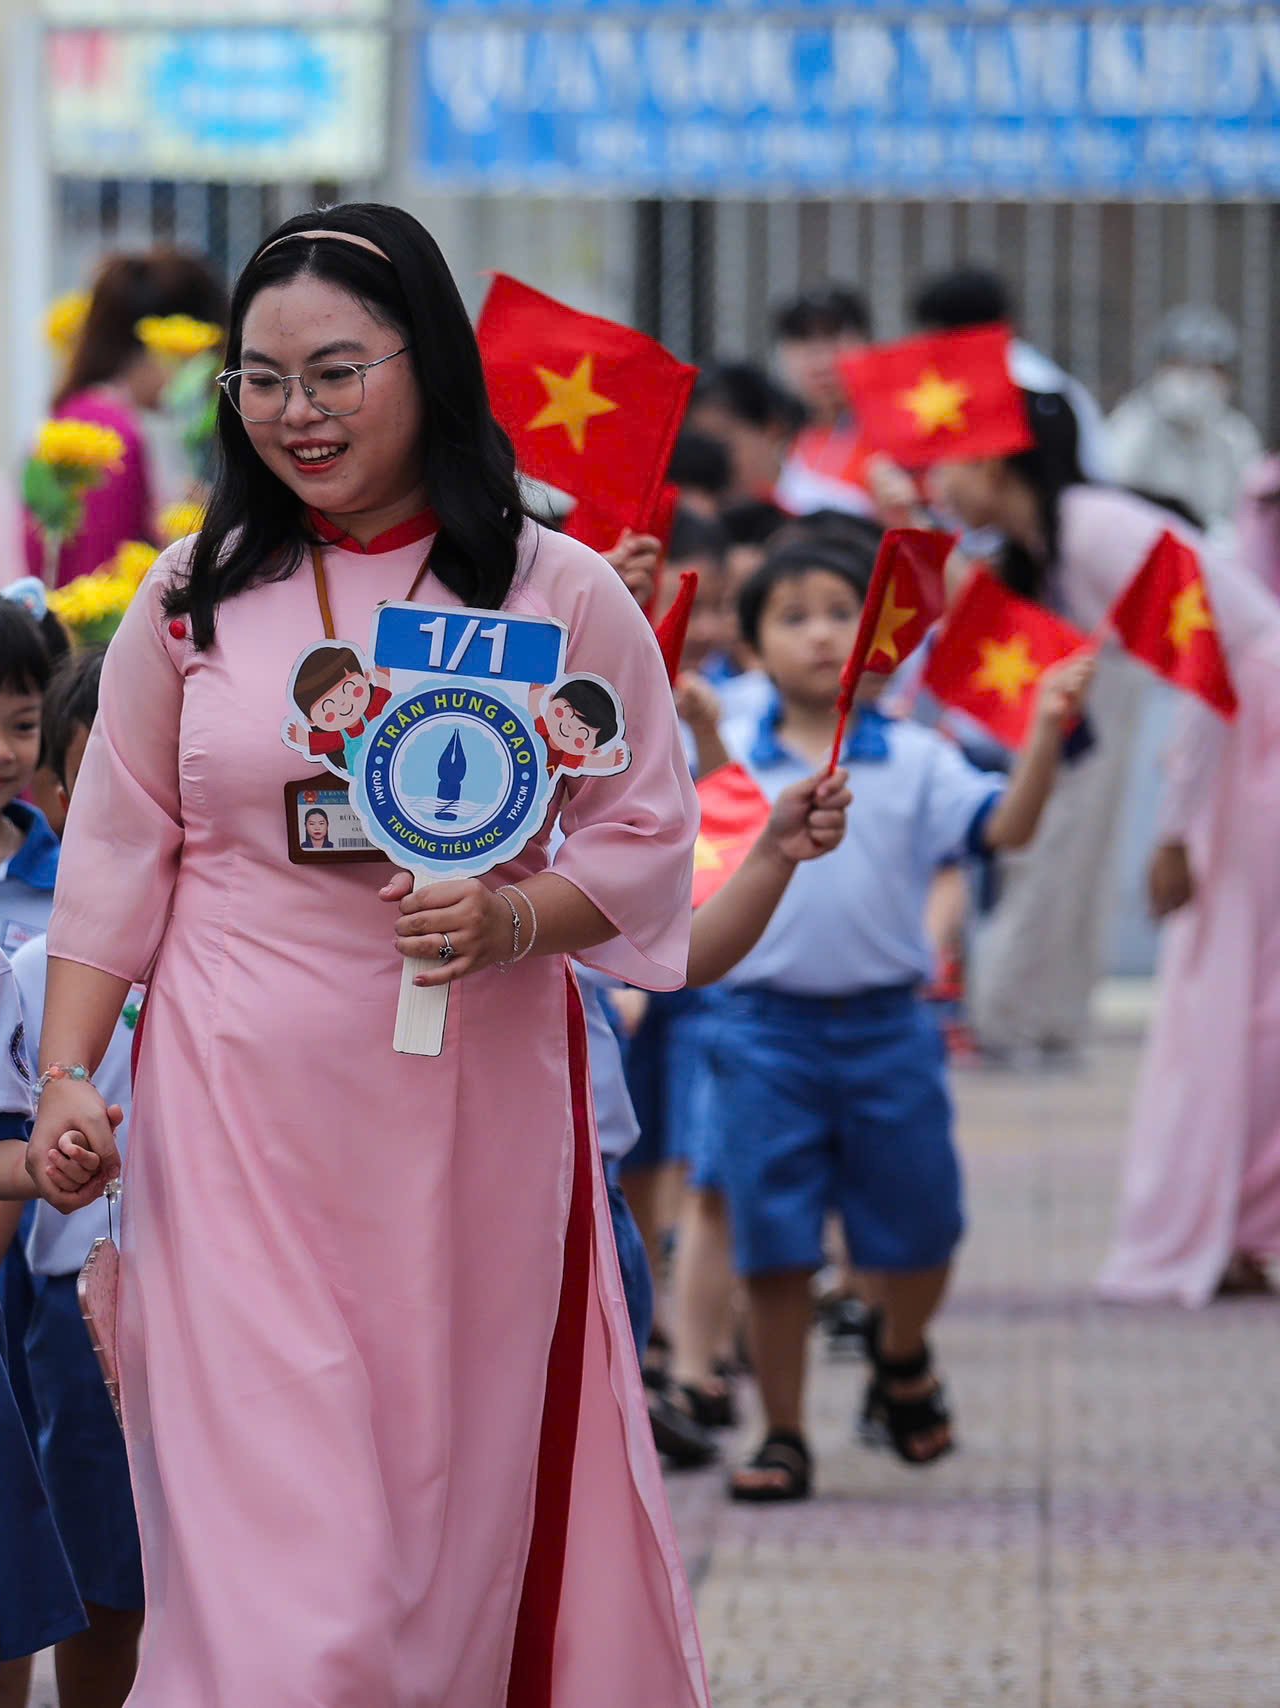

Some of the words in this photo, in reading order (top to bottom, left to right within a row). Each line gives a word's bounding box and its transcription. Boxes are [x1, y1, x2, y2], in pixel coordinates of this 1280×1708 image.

[420, 616, 507, 674] 1/1
[376, 701, 426, 750] TRẦN
[434, 692, 499, 720] HƯNG
[501, 719, 531, 765] ĐẠO
[372, 769, 385, 800] QUẬN
[506, 785, 529, 820] TP.HCM
[387, 815, 437, 852] TRƯỜNG
[441, 840, 471, 854] TIỂU
[475, 826, 503, 849] HỌC
